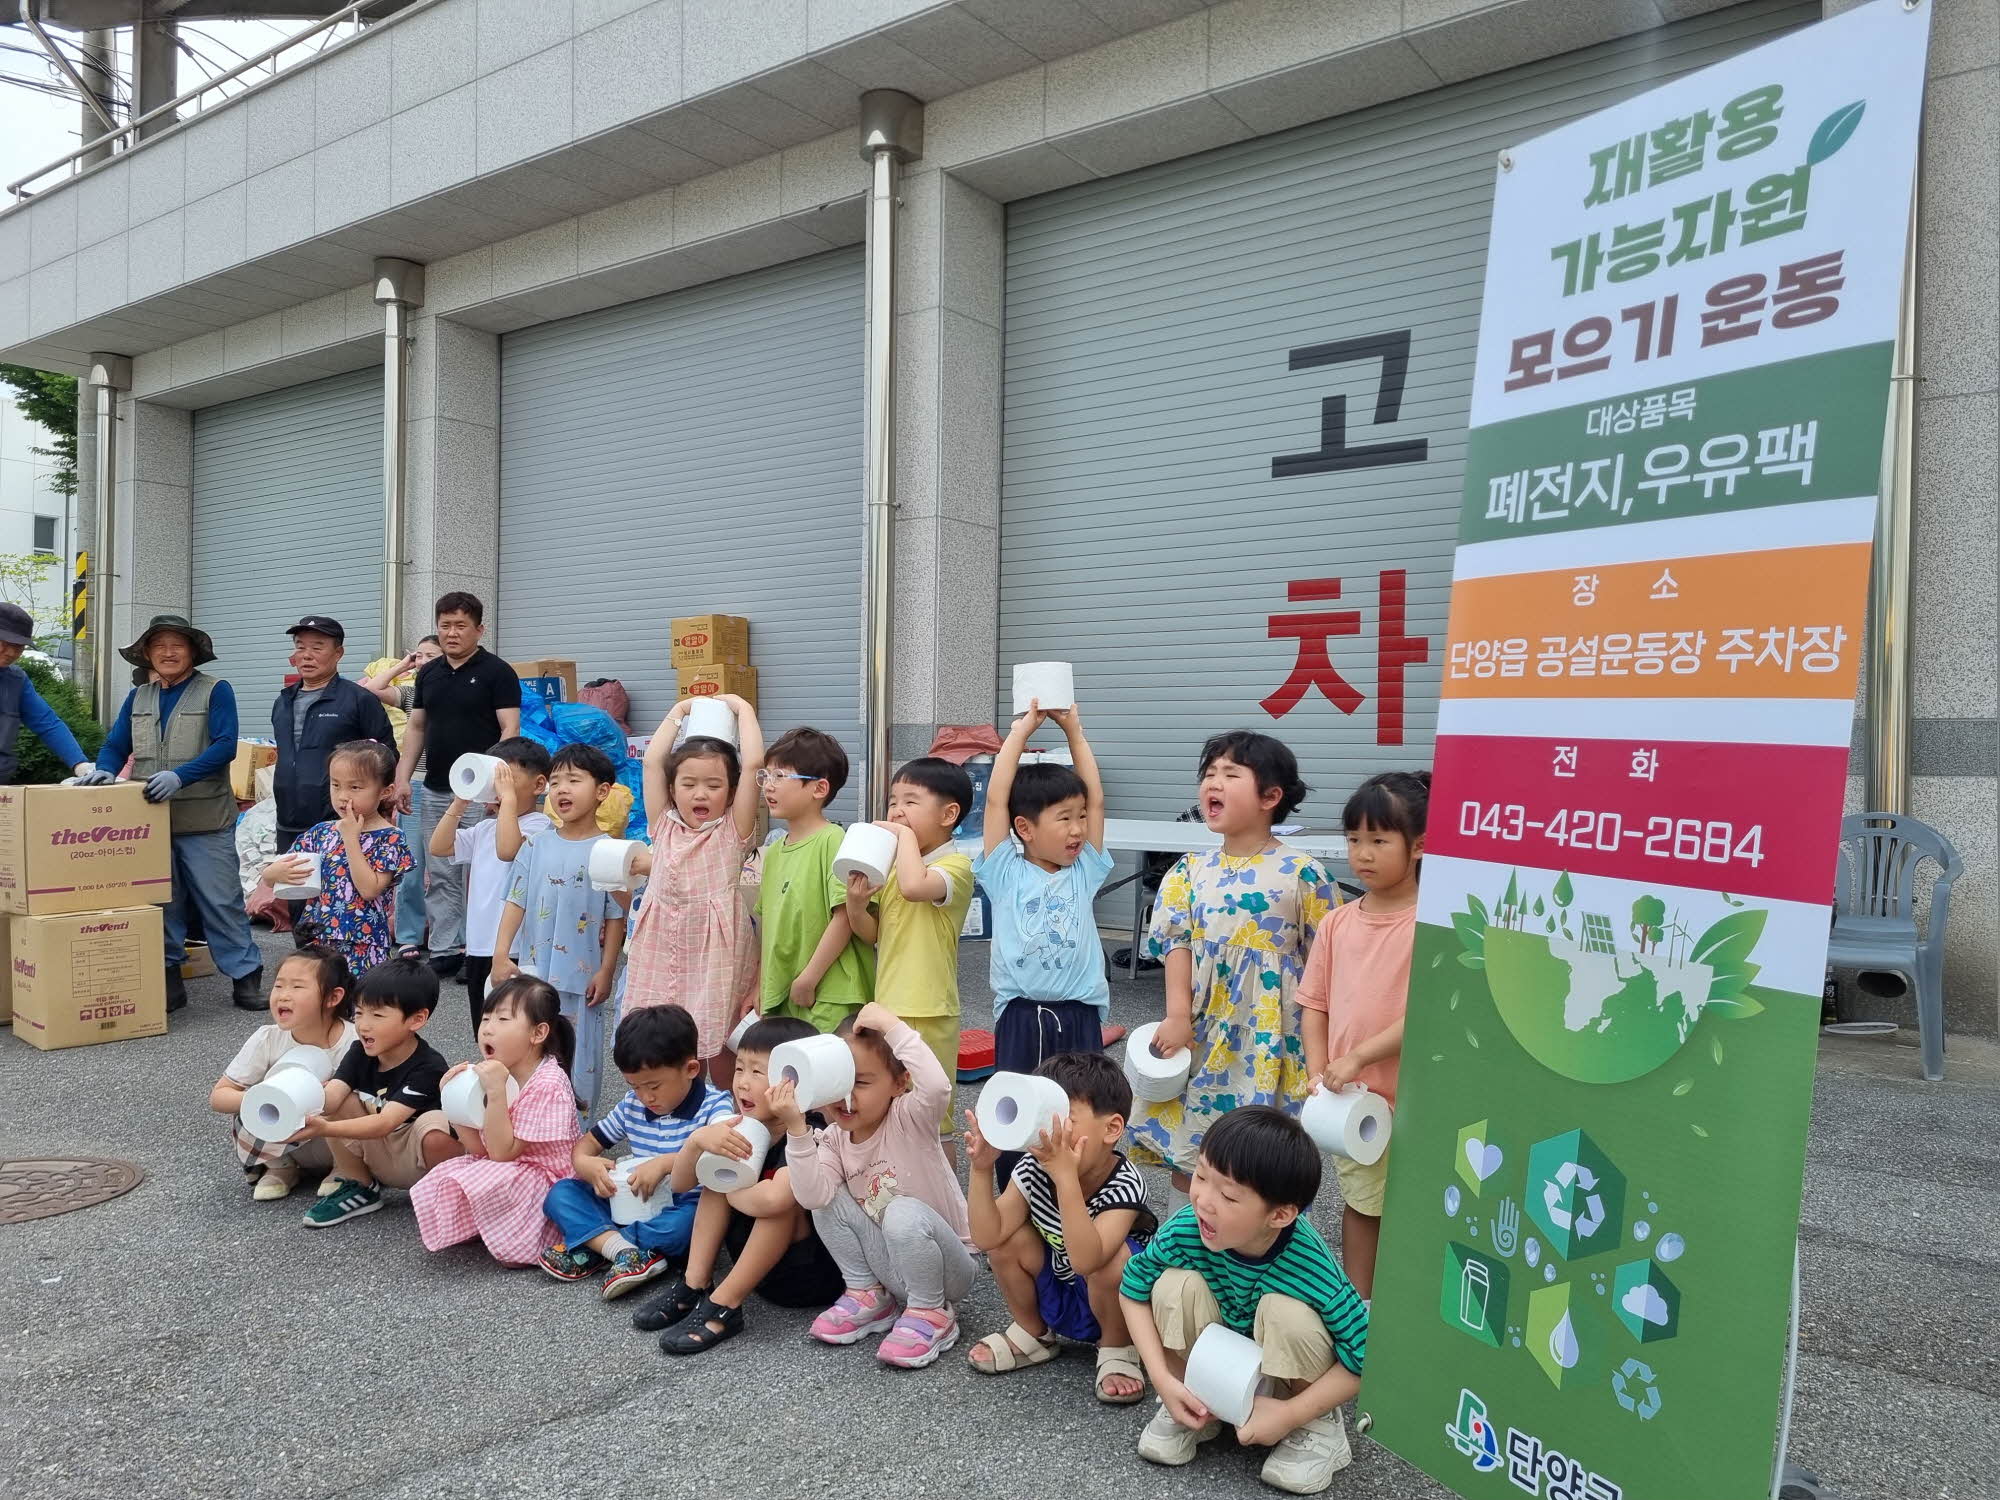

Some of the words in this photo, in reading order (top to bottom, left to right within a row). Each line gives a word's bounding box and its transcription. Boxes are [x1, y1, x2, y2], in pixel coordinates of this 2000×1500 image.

[1583, 83, 1785, 210] 재활용
[1550, 163, 1812, 298] 가능자원
[1503, 293, 1680, 393] 모으기
[1699, 248, 1847, 349] 운동
[1271, 329, 1428, 478] 고
[1586, 387, 1697, 437] 대상품목
[1484, 420, 1819, 524] 폐전지,우유팩
[1258, 568, 1429, 747] 차
[1449, 636, 1529, 679] 단양읍
[1536, 629, 1707, 677] 공설운동장
[1715, 624, 1848, 674] 주차장
[546, 683, 555, 695] A
[51, 823, 151, 846] theVenti
[92, 806, 103, 814] 98
[1459, 800, 1765, 869] 043-420-2684
[80, 920, 130, 934] theVenti
